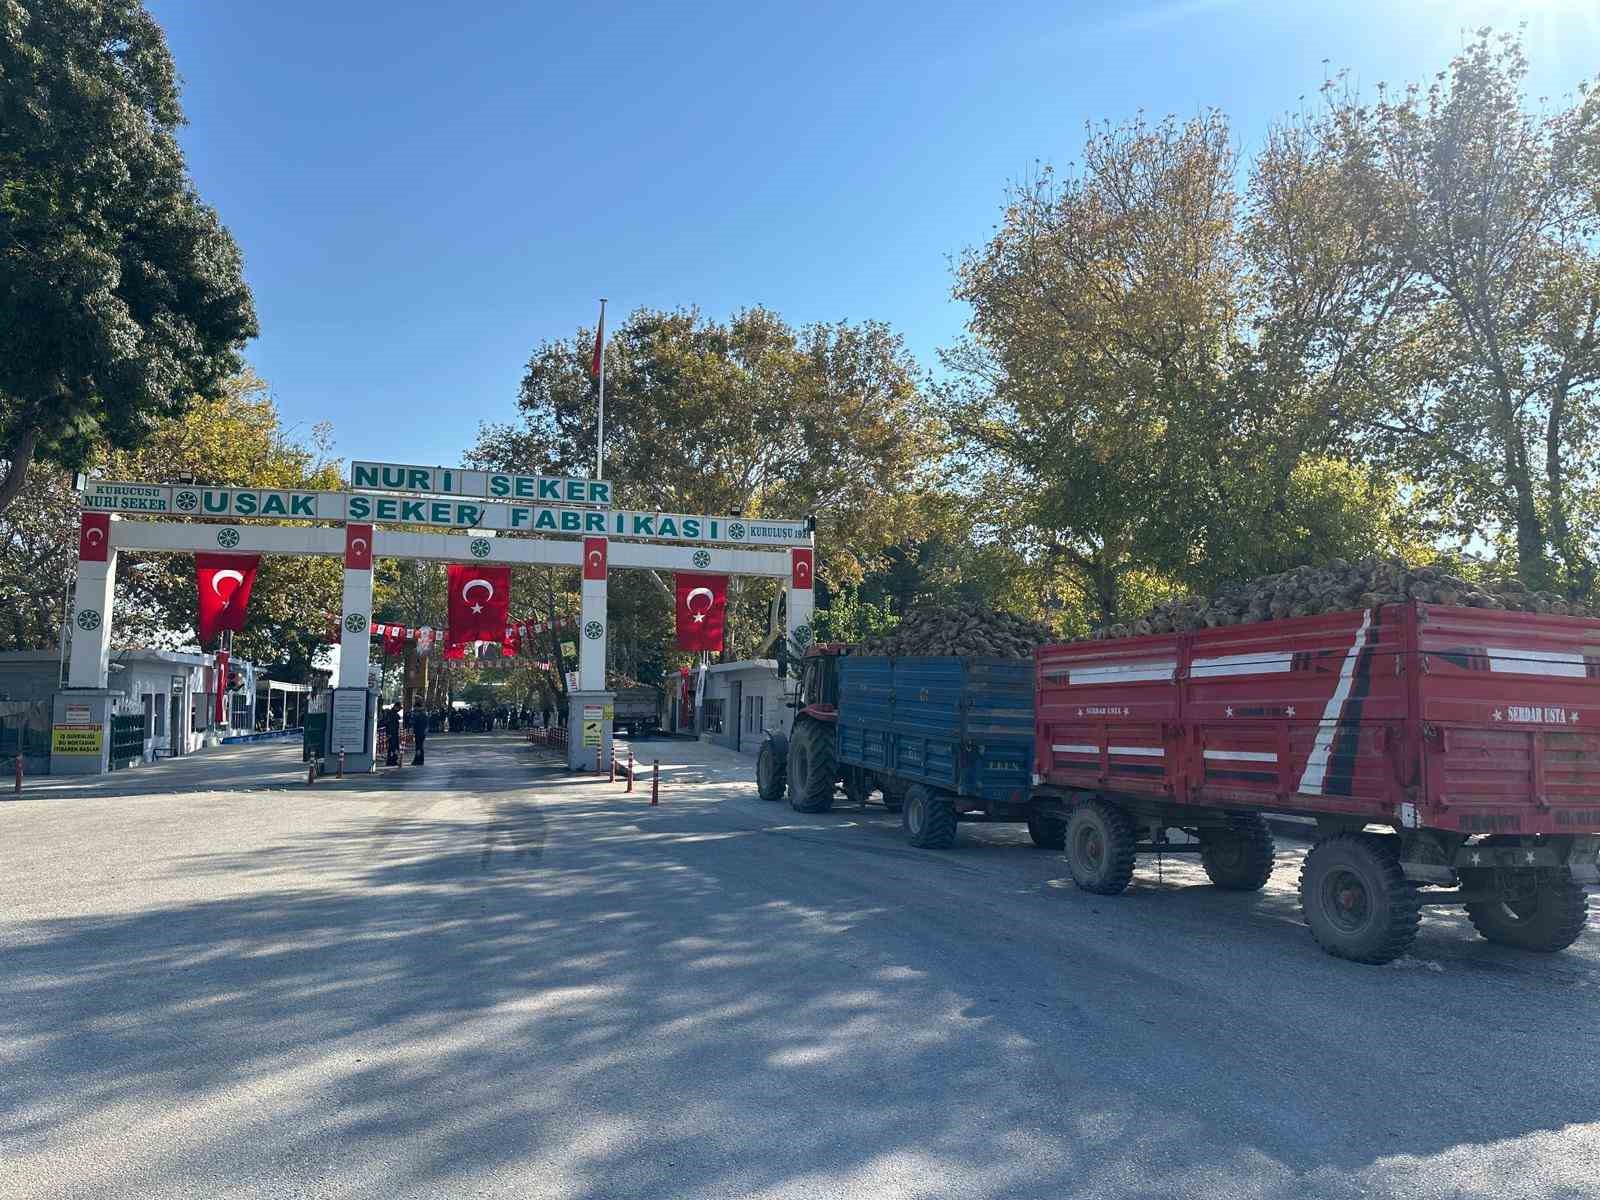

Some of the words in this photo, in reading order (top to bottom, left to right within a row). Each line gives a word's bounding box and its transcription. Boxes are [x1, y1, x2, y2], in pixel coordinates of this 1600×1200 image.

[355, 465, 452, 491] NURİ
[96, 485, 160, 497] KURUCUSU
[204, 491, 314, 516] UŞAK
[349, 496, 479, 525] ŞEKER
[512, 507, 718, 539] FABRİKASI
[1507, 706, 1542, 722] SERDAR
[1544, 708, 1567, 723] USTA
